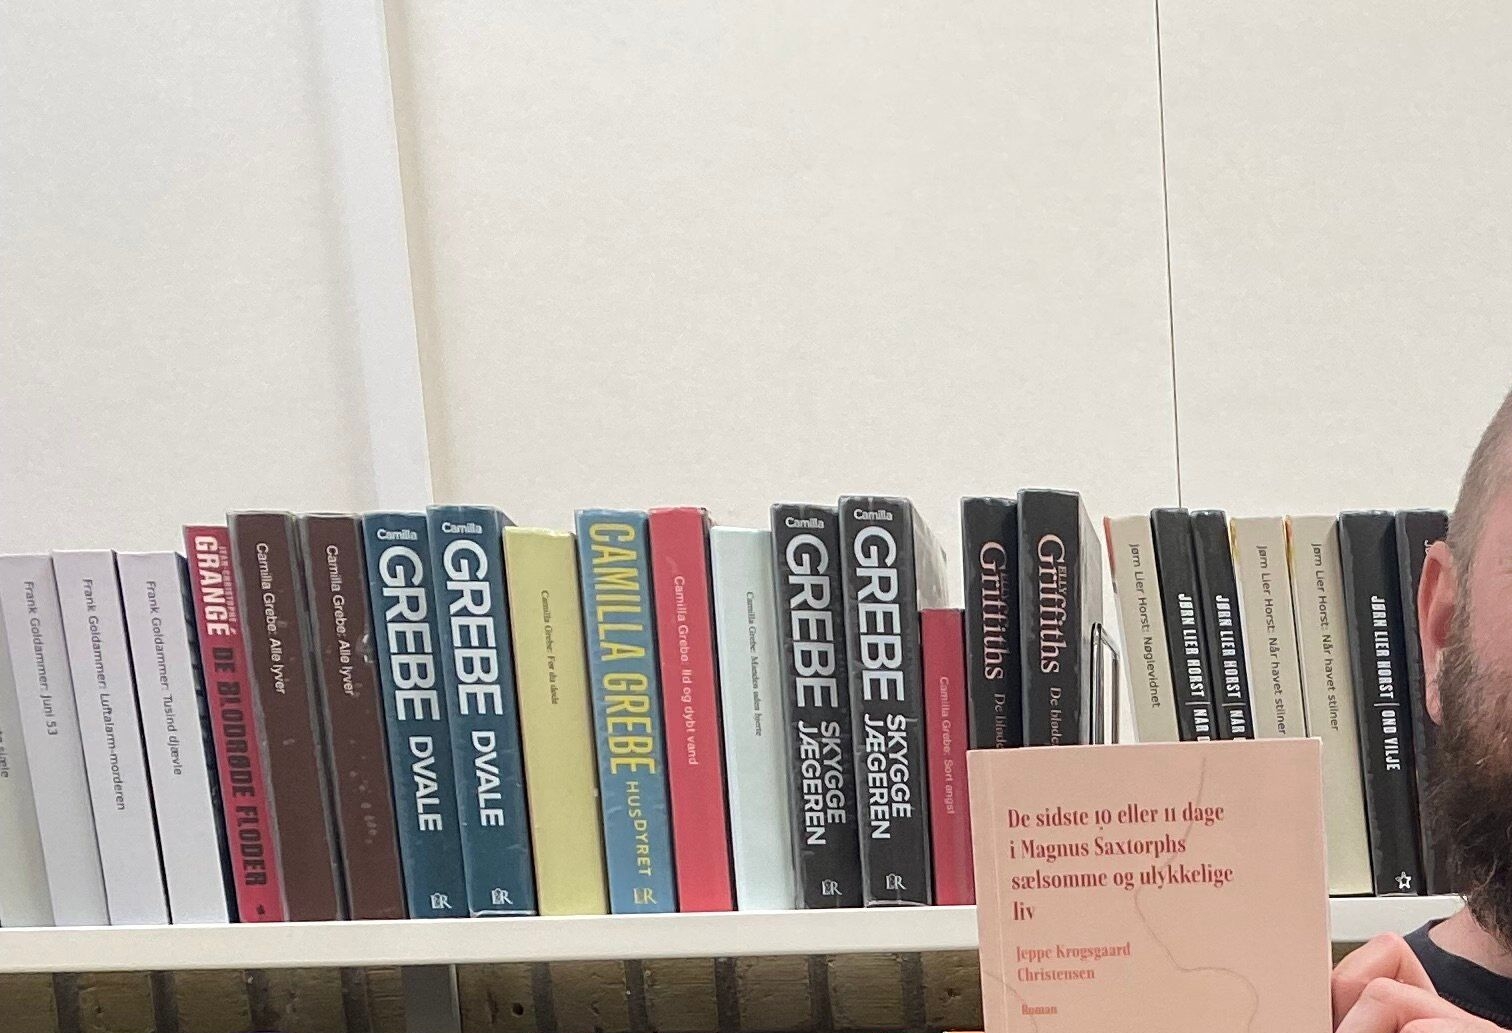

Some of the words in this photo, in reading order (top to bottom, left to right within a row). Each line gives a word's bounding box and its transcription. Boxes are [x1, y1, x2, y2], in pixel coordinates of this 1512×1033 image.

[194, 535, 237, 636] GRANGÉ
[588, 522, 646, 662] CAMILLA
[1038, 534, 1067, 674] Griffiths
[1129, 543, 1140, 569] Jørn
[1134, 571, 1145, 597] Lier
[146, 580, 157, 614] Frank
[164, 694, 177, 737] Tusind
[256, 542, 272, 593] Camilla
[271, 664, 285, 694] lyver
[443, 539, 504, 716] GREBE
[786, 533, 838, 709] GREBE
[853, 526, 905, 701] GREBE
[980, 542, 1009, 680] Griffiths
[1371, 595, 1386, 629] JØRN
[1374, 630, 1390, 659] LIER
[213, 648, 235, 673] DE
[378, 545, 440, 721] GREBE
[409, 736, 442, 831] DVALE
[1144, 636, 1160, 708] Nøglevidnet
[1377, 660, 1393, 699] HORST
[217, 681, 257, 797] BLODRØDE
[602, 671, 656, 775] GREBE
[886, 714, 911, 819] SKYGGE
[1380, 709, 1396, 735] OND
[1384, 736, 1401, 771] VILJE
[472, 730, 505, 827] DVALE
[798, 721, 826, 845] JÆGEREN
[821, 721, 846, 824] SKYGGE
[864, 714, 891, 839] JÆGEREN
[1007, 808, 1030, 828] De
[1036, 806, 1089, 827] sidste
[1118, 805, 1158, 825] eller
[1182, 802, 1225, 825] dage
[235, 806, 267, 886] FLODER
[625, 780, 653, 877] HUSDYRET
[1010, 840, 1016, 860] i
[1021, 837, 1090, 864] Magnus
[1094, 834, 1187, 859] Saxtorphs
[1011, 868, 1108, 890] sælsomme
[1112, 870, 1135, 890] og
[1140, 863, 1235, 889] ulykkelige
[1012, 901, 1035, 921] liv
[1016, 945, 1053, 963] Jeppe
[1056, 942, 1131, 961] Krogsgaard
[1017, 966, 1095, 983] Christensen
[1021, 1003, 1058, 1016] Roman
